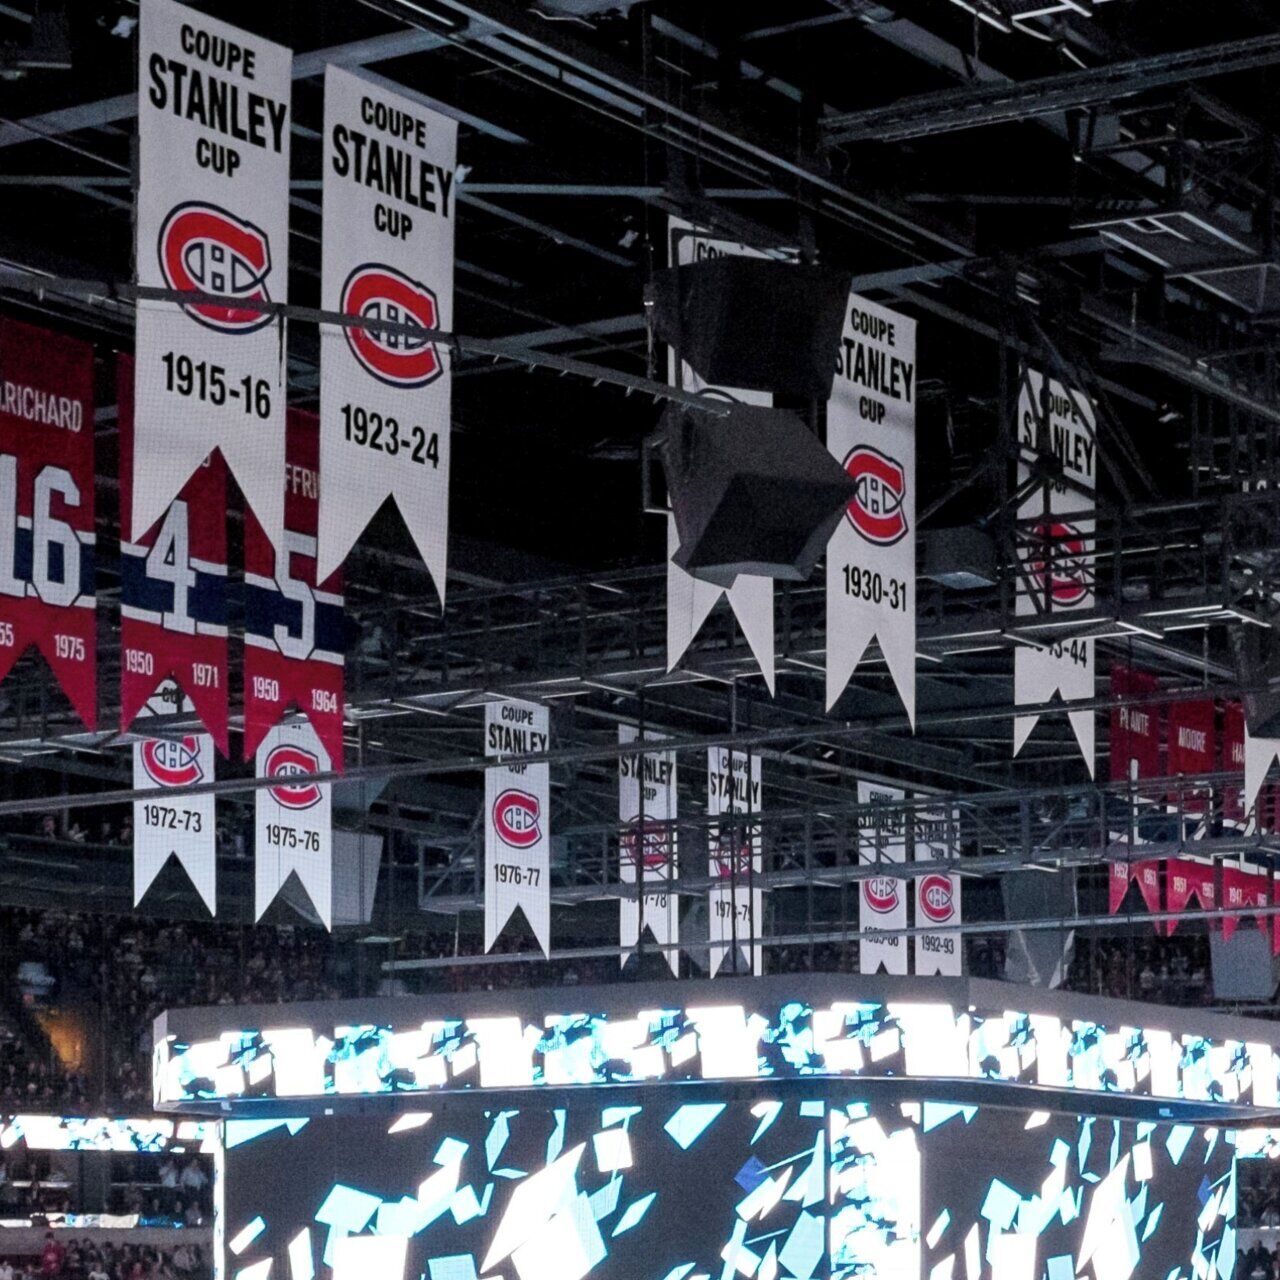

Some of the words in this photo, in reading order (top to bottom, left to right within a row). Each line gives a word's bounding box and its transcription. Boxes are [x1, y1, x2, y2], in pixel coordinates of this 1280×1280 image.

[181, 24, 255, 79] COUPE
[150, 53, 287, 153] STANLEY
[362, 97, 426, 148] COUPE
[196, 138, 240, 177] CUP
[333, 124, 453, 218] STANLEY
[374, 204, 413, 241] CUP
[851, 307, 896, 347] COUPE
[162, 352, 270, 419] 1915-16
[836, 337, 913, 403] STANLEY
[859, 399, 886, 425] CUP
[341, 404, 440, 470] 1923-24
[146, 500, 195, 635] 4
[842, 563, 907, 613] 1930-31
[53, 632, 86, 664] 1975
[124, 646, 155, 677] 1950
[191, 660, 220, 689] 1971
[251, 675, 280, 704] 1950
[311, 687, 338, 715] 1964
[502, 704, 534, 727] COUPE
[488, 723, 549, 753] STANLEY
[142, 805, 202, 834] 1972-73
[264, 823, 321, 854] 1975-76
[492, 862, 541, 888] 1976-77
[921, 934, 955, 954] 1992-93
